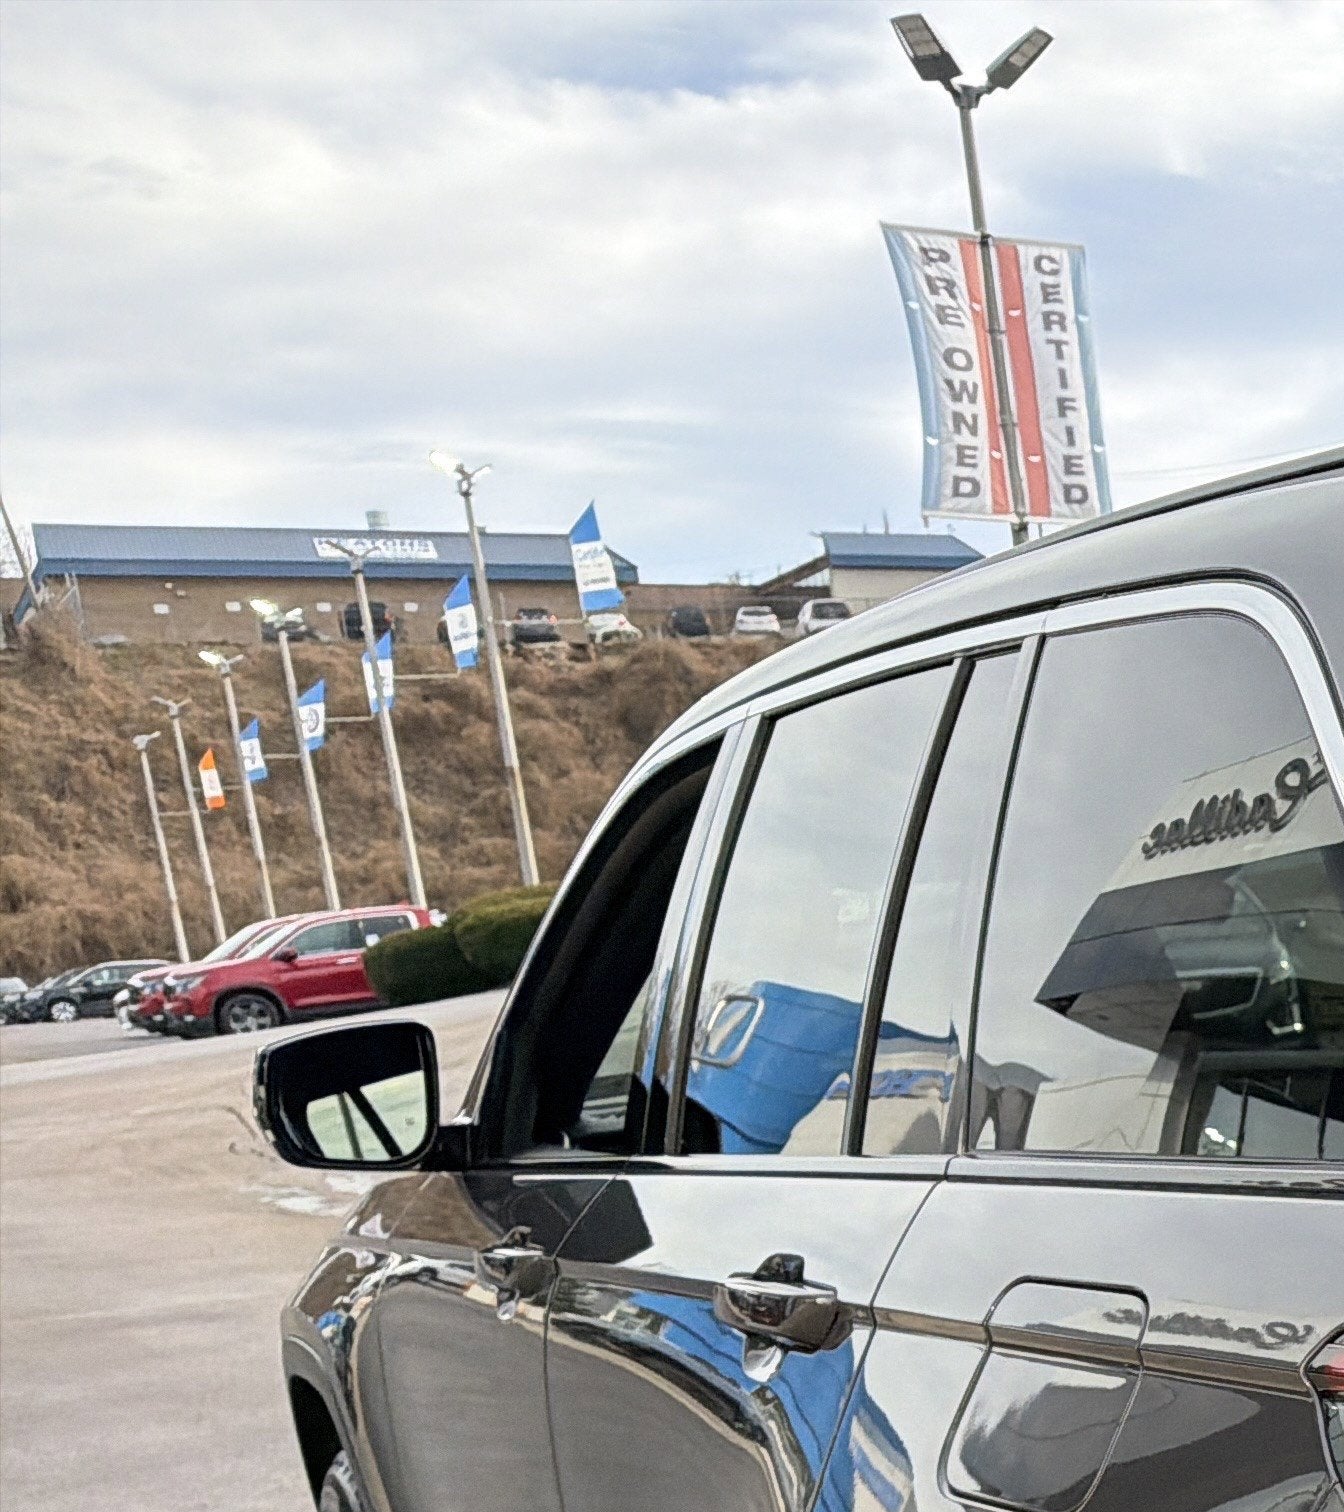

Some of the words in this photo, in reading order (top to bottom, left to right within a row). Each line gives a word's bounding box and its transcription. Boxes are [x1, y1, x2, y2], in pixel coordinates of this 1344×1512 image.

[919, 246, 965, 329] PRE
[942, 347, 981, 499] OWNED
[1033, 254, 1089, 506] CERTIFIED
